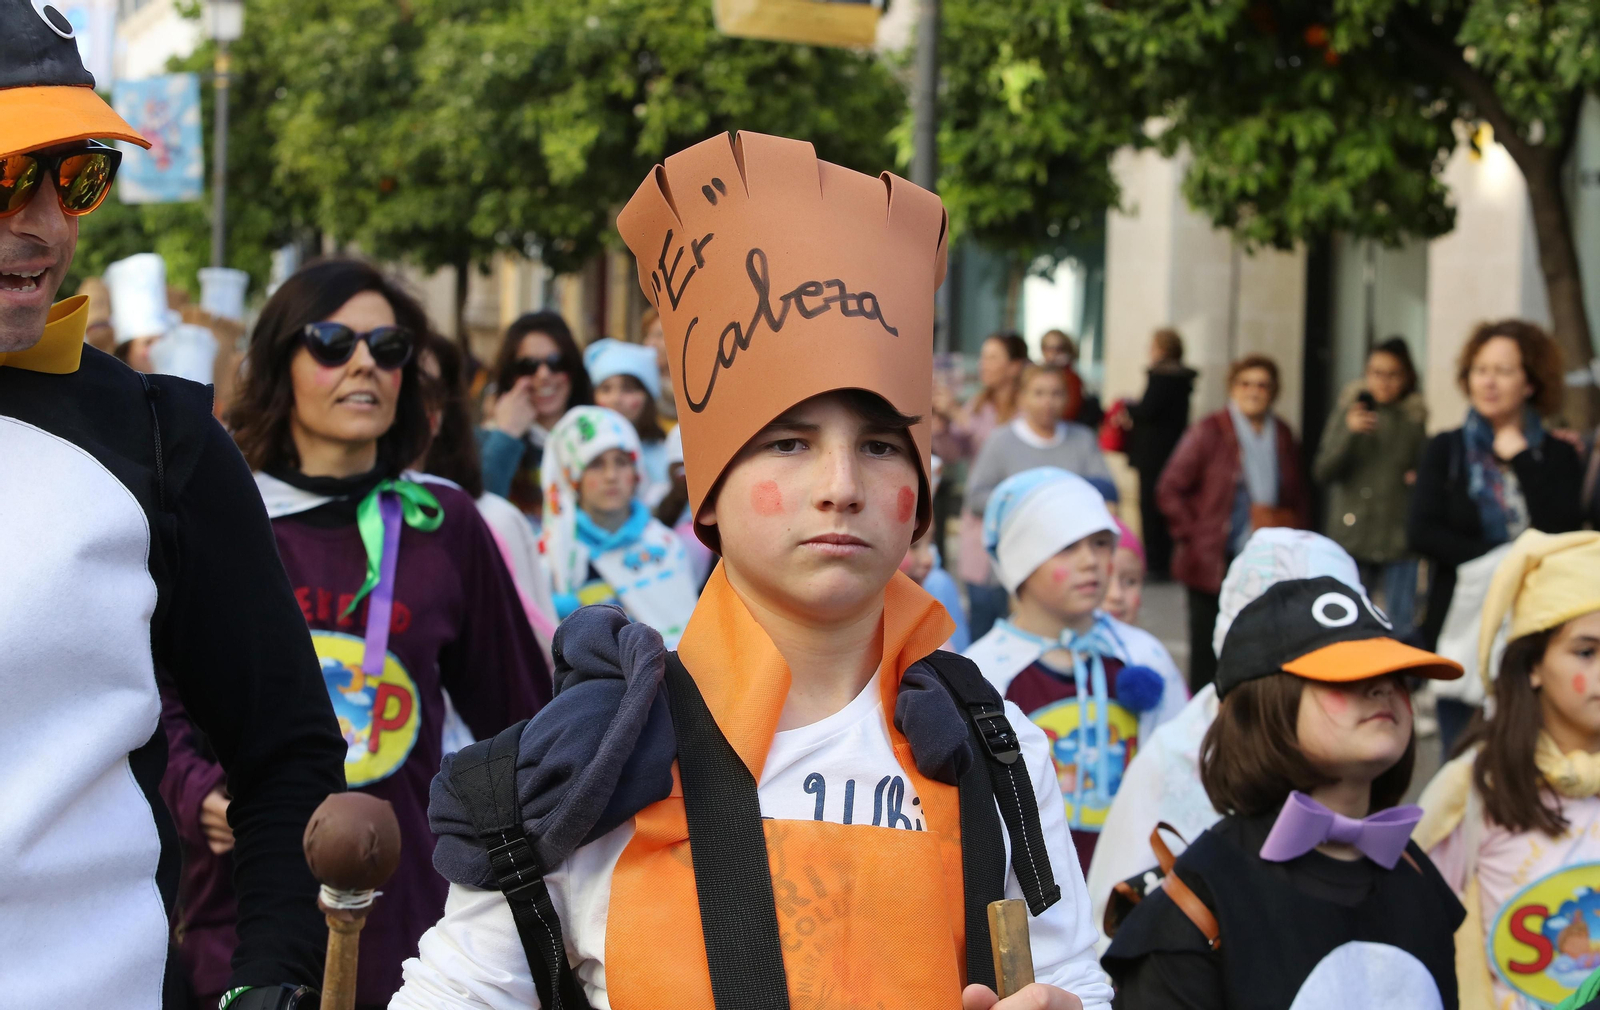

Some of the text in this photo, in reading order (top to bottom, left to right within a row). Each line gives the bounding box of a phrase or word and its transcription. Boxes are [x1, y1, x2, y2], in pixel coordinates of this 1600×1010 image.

[682, 247, 899, 413] Cabeza
[367, 681, 413, 754] P
[1508, 903, 1554, 975] S
